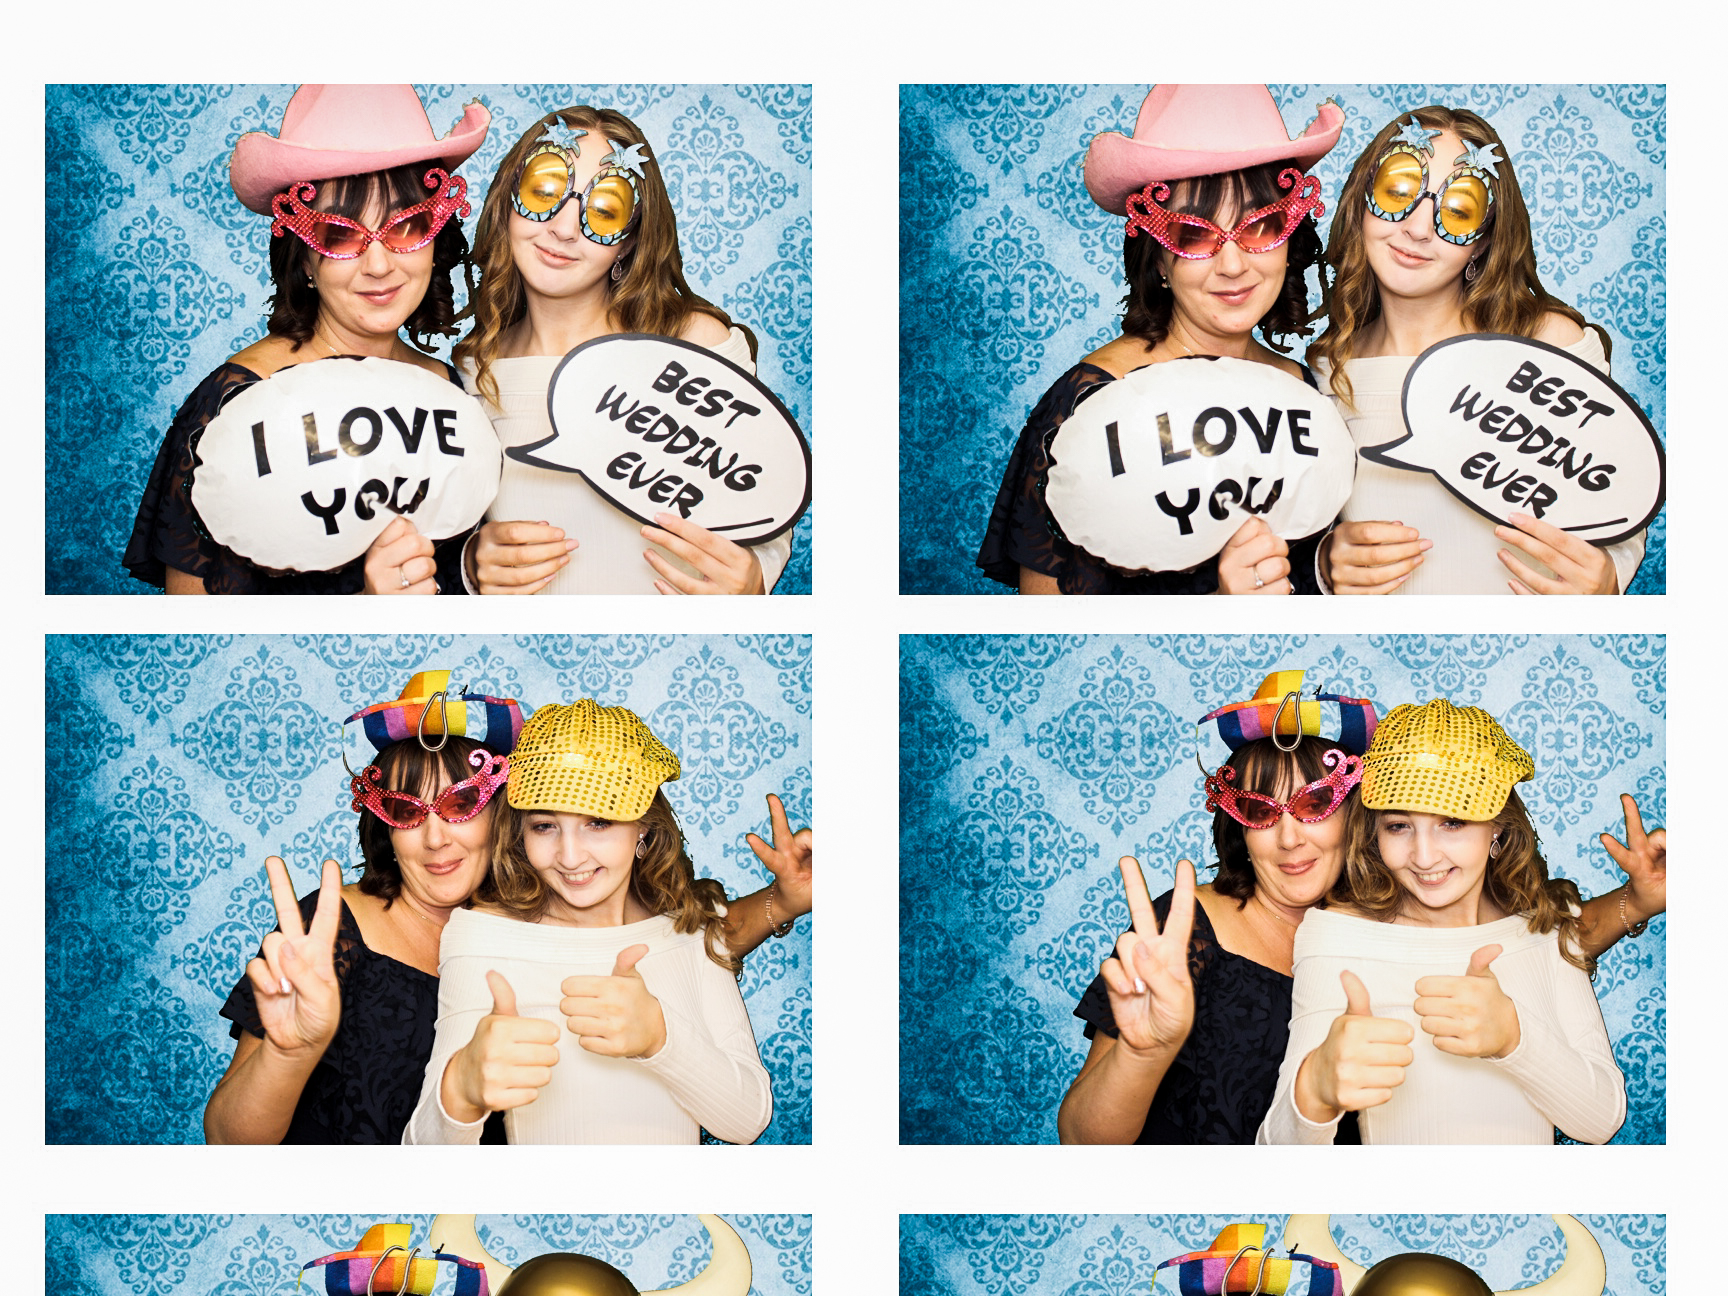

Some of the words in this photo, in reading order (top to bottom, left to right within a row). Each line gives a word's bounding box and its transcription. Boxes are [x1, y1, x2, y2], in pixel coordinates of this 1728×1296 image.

[651, 360, 761, 429] BEST
[1505, 360, 1615, 429] BEST
[251, 420, 273, 478] I
[302, 406, 465, 466] LOVE
[595, 384, 763, 492] WEDDING
[1105, 420, 1127, 478] I
[1156, 406, 1319, 466] LOVE
[1449, 384, 1617, 492] WEDDING
[606, 451, 704, 520] EVER
[1460, 451, 1558, 520] EVER
